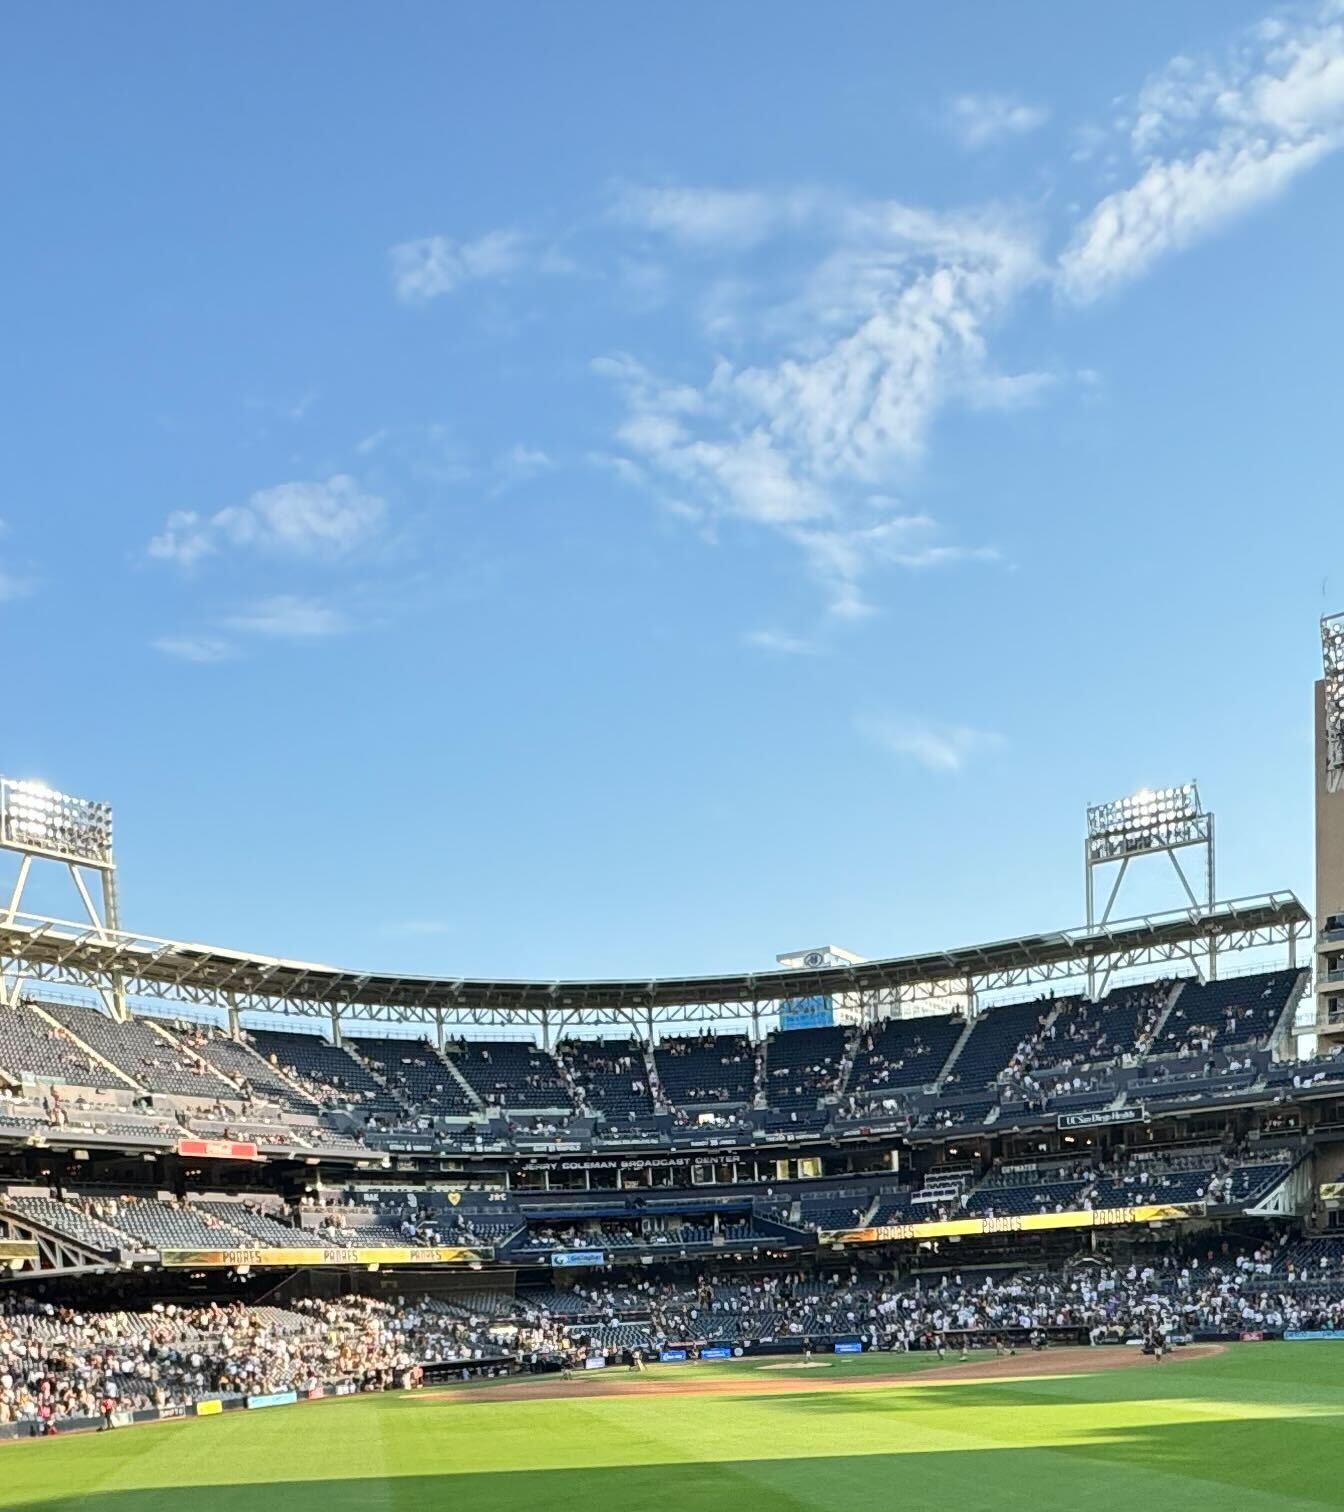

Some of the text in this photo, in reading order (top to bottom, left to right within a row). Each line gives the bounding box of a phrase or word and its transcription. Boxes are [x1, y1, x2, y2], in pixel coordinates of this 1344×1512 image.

[521, 1154, 741, 1171] JERRY COLEMAN BROADCAST CENTER
